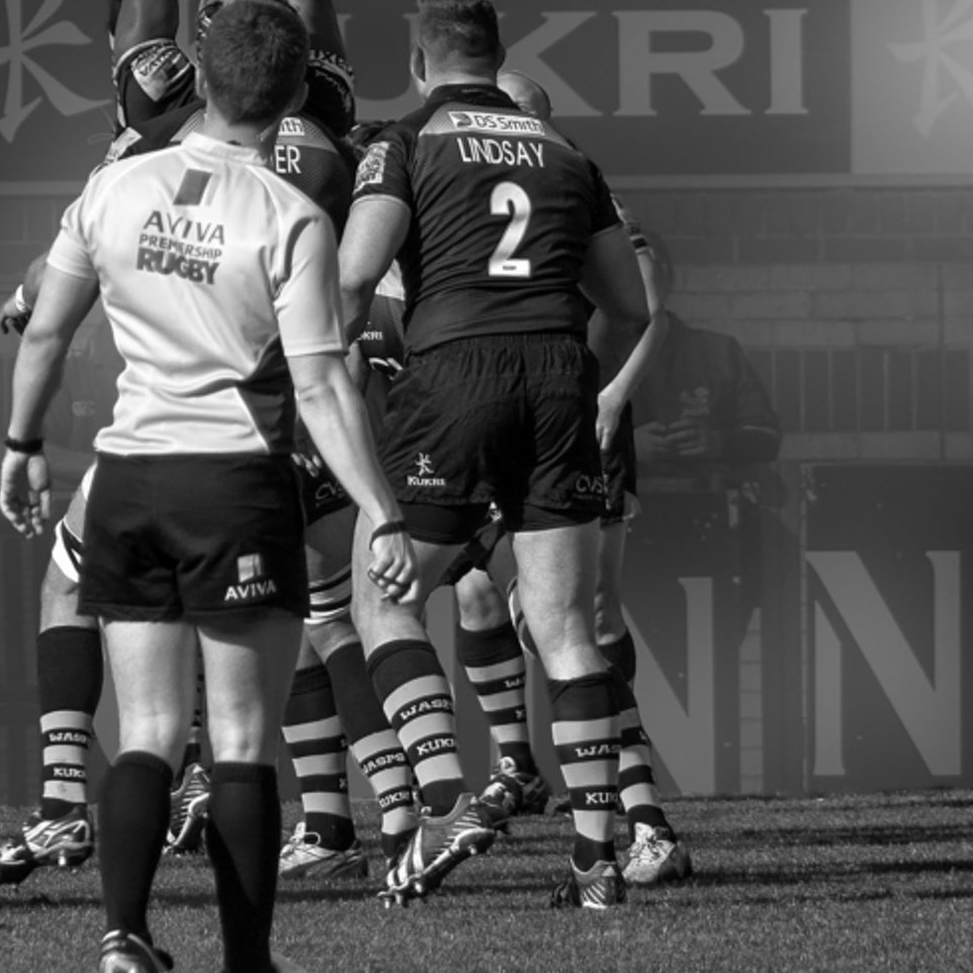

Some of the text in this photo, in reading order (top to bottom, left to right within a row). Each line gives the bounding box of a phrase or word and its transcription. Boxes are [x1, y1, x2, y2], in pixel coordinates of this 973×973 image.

[275, 145, 301, 174] ER
[457, 137, 545, 168] LINDSAY
[142, 210, 225, 246] AVIVA
[488, 181, 532, 277] 2
[136, 248, 220, 285] RUGBY
[224, 579, 277, 602] AVIVA
